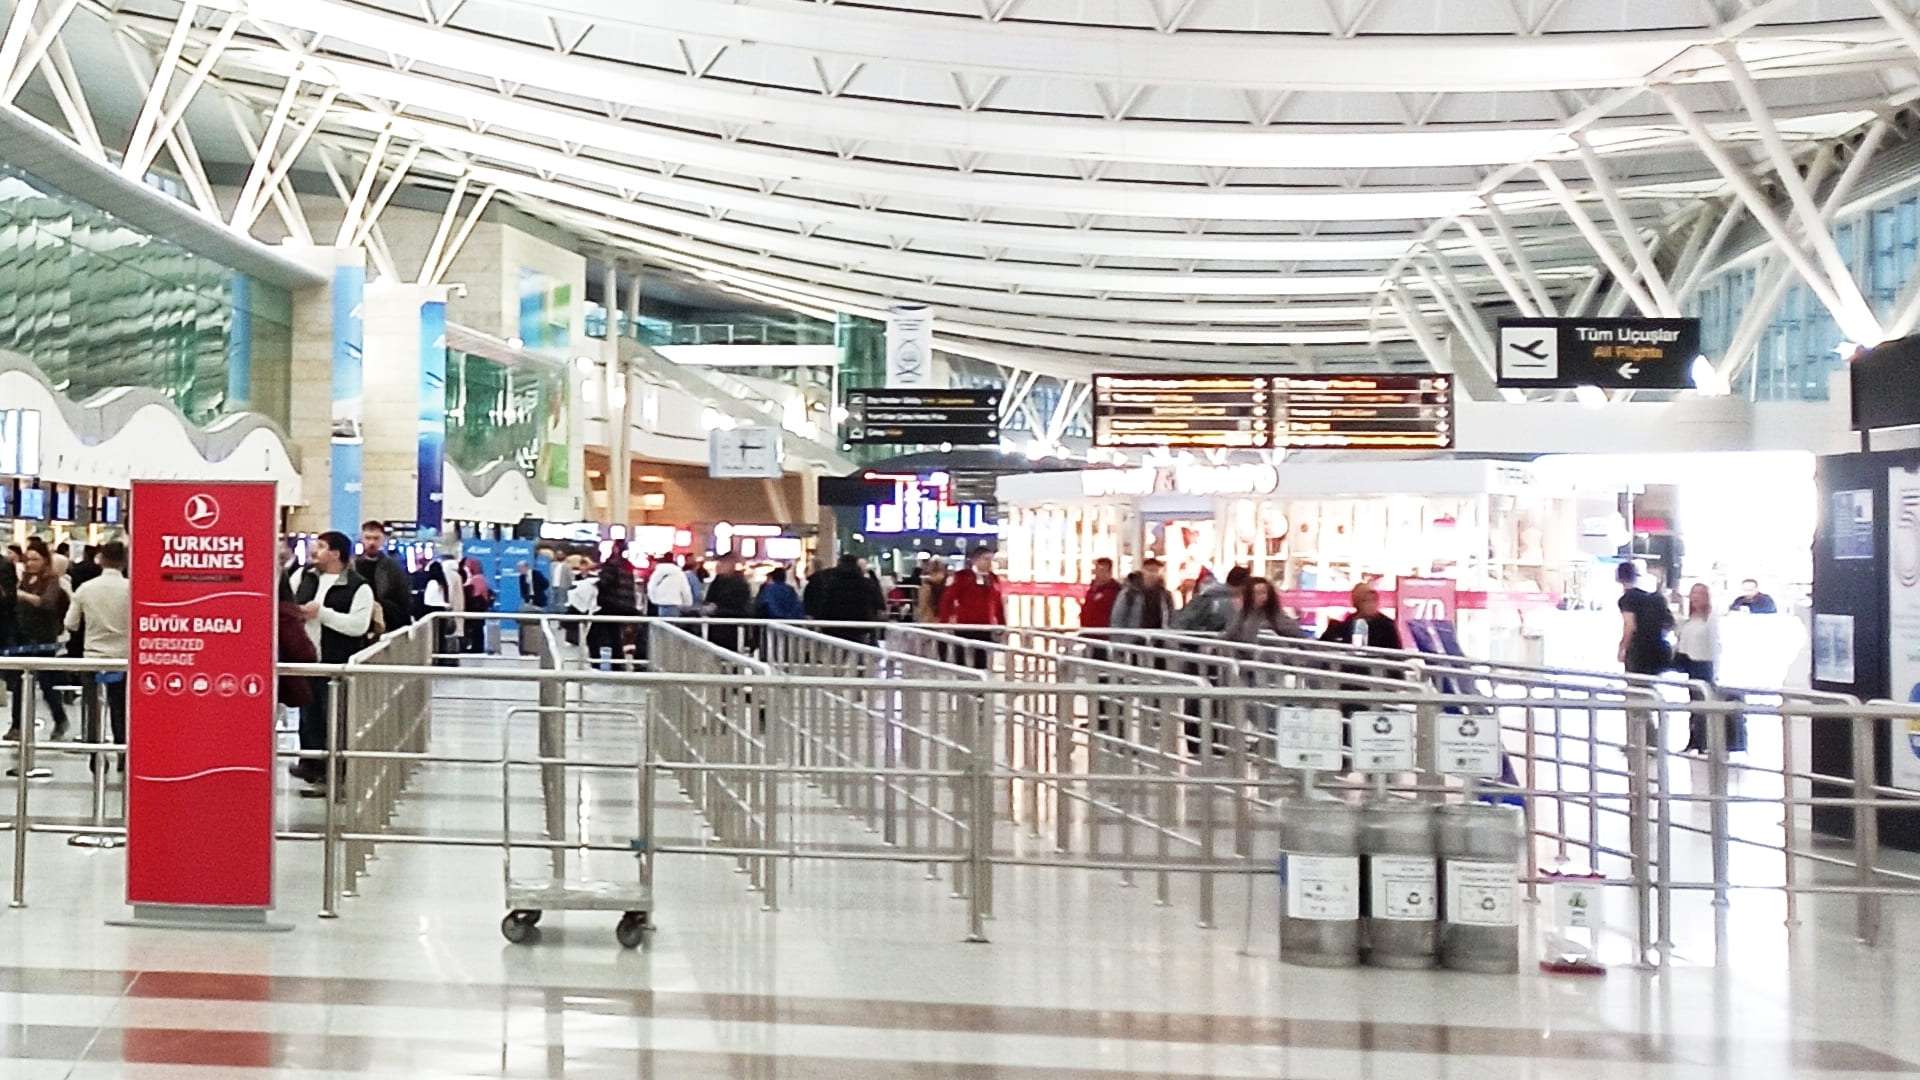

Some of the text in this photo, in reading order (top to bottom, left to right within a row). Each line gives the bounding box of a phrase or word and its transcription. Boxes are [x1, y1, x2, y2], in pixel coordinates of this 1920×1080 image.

[1575, 327, 1681, 345] Tüm Uçuşlar
[161, 535, 244, 552] TURKISH
[160, 552, 244, 569] AIRLINES
[139, 613, 242, 633] BÜYÜK BAGAJ
[138, 637, 204, 651] OVERSIZED
[138, 652, 195, 666] BAGGAGE
